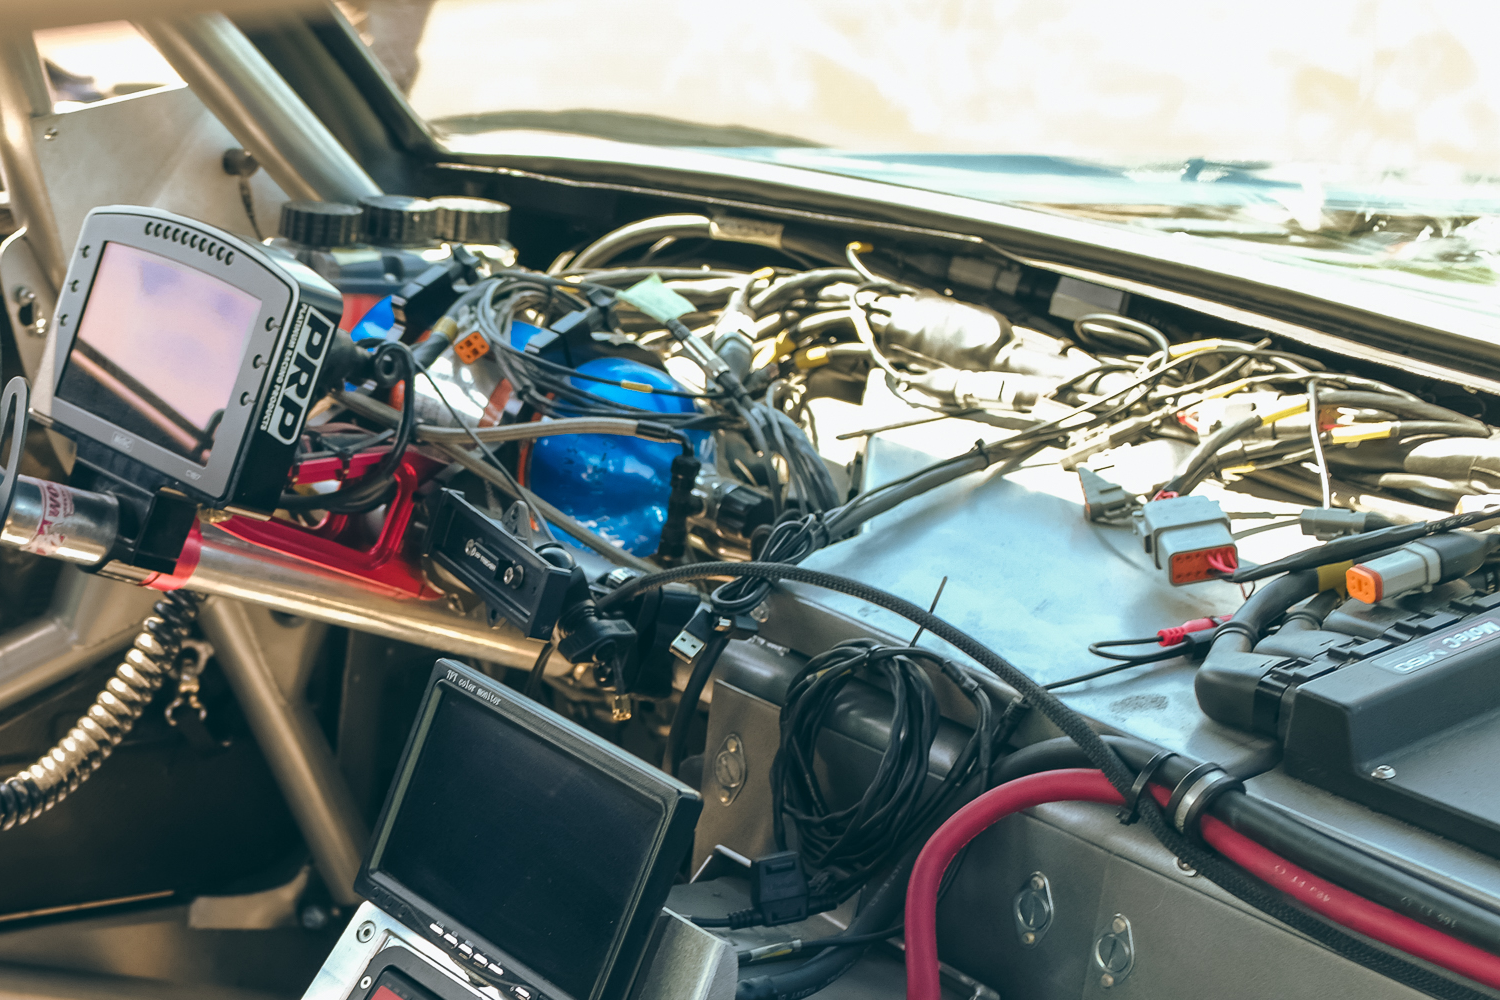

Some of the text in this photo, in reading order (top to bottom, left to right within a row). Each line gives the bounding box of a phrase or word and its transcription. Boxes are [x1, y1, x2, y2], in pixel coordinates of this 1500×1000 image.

[260, 303, 308, 431] PLATINUM RACING PRODUCTS
[277, 312, 331, 441] PRP
[458, 678, 476, 693] color
[476, 687, 502, 706] monitor
